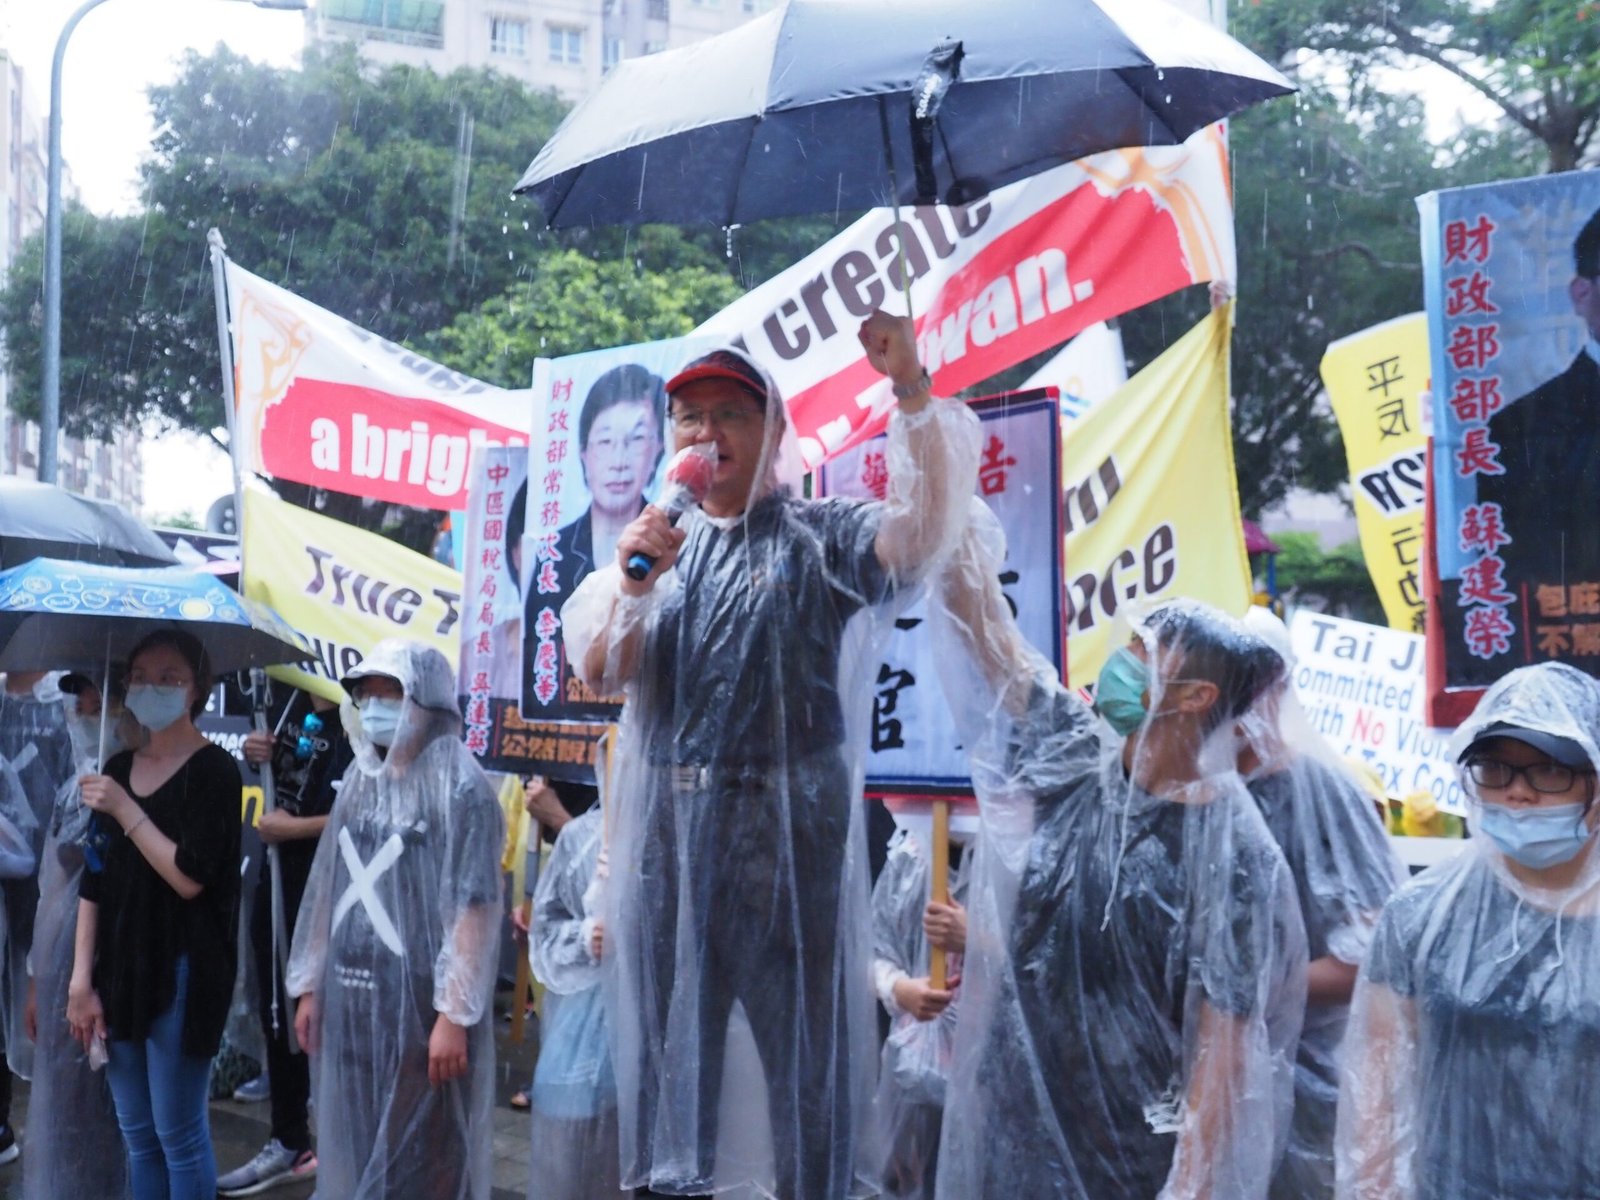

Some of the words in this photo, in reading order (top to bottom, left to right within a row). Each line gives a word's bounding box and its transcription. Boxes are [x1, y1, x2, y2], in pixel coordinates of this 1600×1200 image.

[763, 199, 992, 361] create
[1444, 216, 1506, 478] 財政部部長
[310, 417, 340, 472] a
[351, 413, 526, 497] brig
[540, 378, 574, 594] 財政部常務次長
[304, 545, 423, 626] True
[476, 463, 509, 656] 中區國稅局局長
[1459, 504, 1515, 656] 蘇建榮
[1296, 666, 1417, 713] ommitted
[1311, 620, 1377, 664] Tai
[1351, 708, 1386, 747] No
